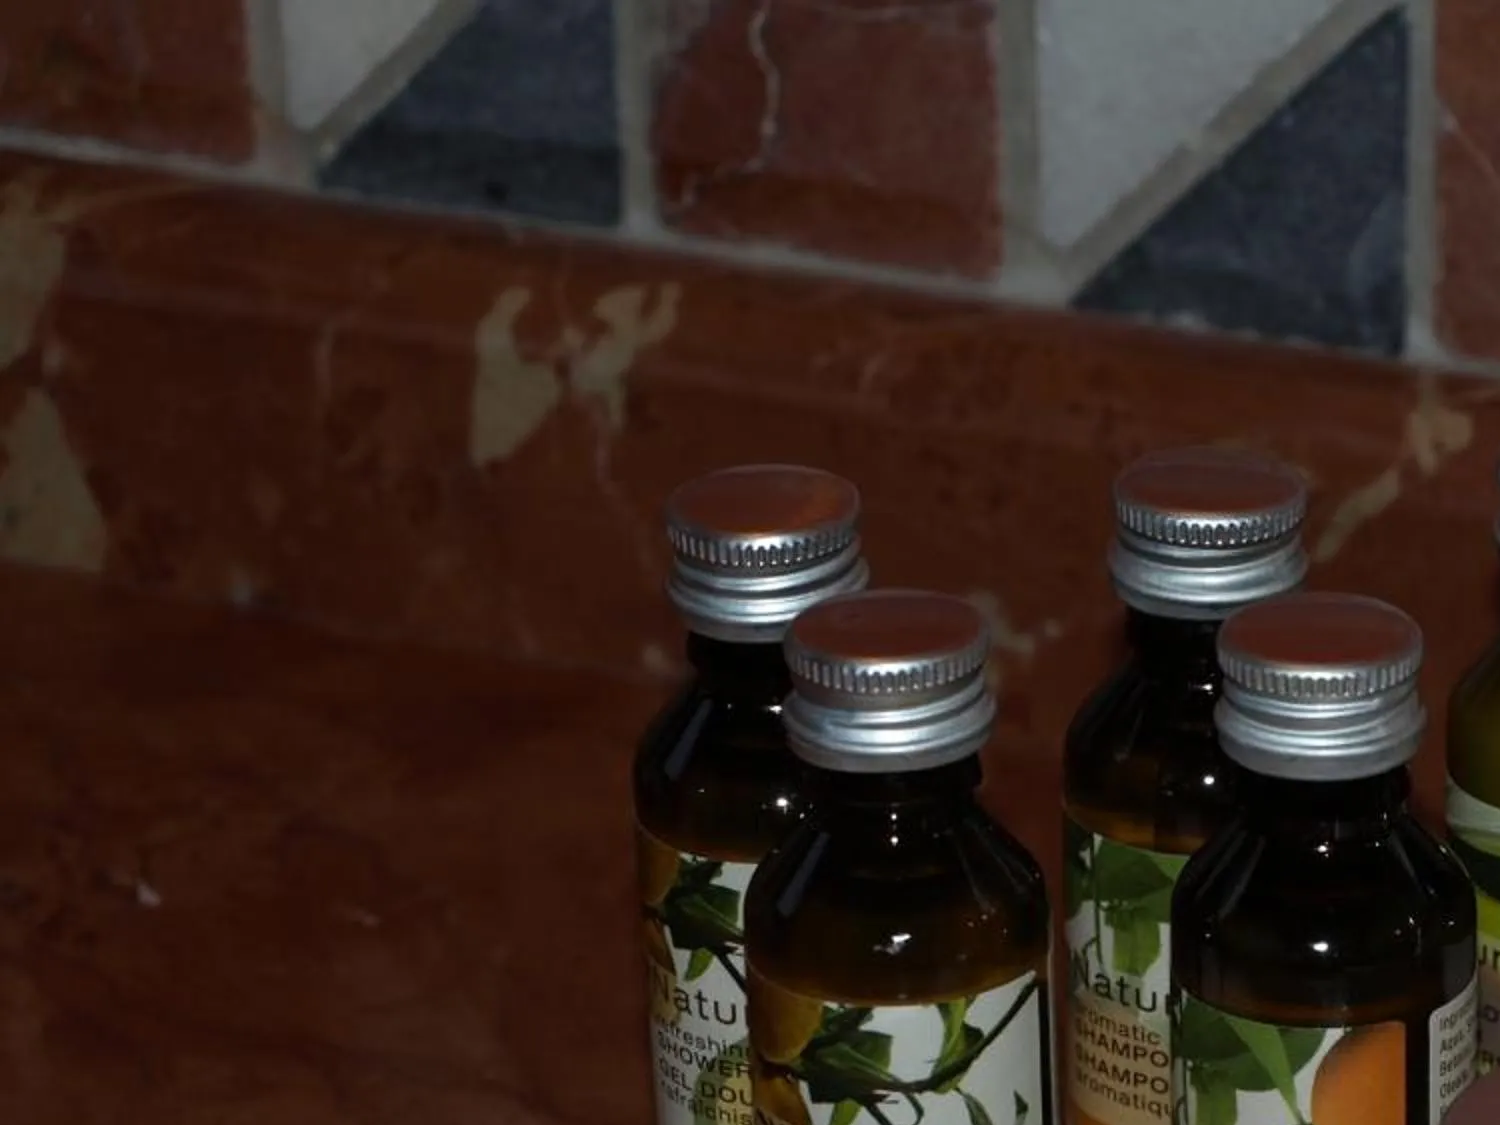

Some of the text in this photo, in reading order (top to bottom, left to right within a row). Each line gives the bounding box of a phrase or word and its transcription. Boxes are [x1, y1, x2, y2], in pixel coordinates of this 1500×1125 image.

[653, 964, 737, 1025] Natu
[1072, 949, 1178, 1016] Natur
[659, 1015, 751, 1058] refreshin
[1075, 1017, 1169, 1068] SHAMPO
[700, 1080, 755, 1108] DOU
[1075, 1042, 1169, 1094] SHAMPO
[1077, 1065, 1173, 1120] aromatiqu
